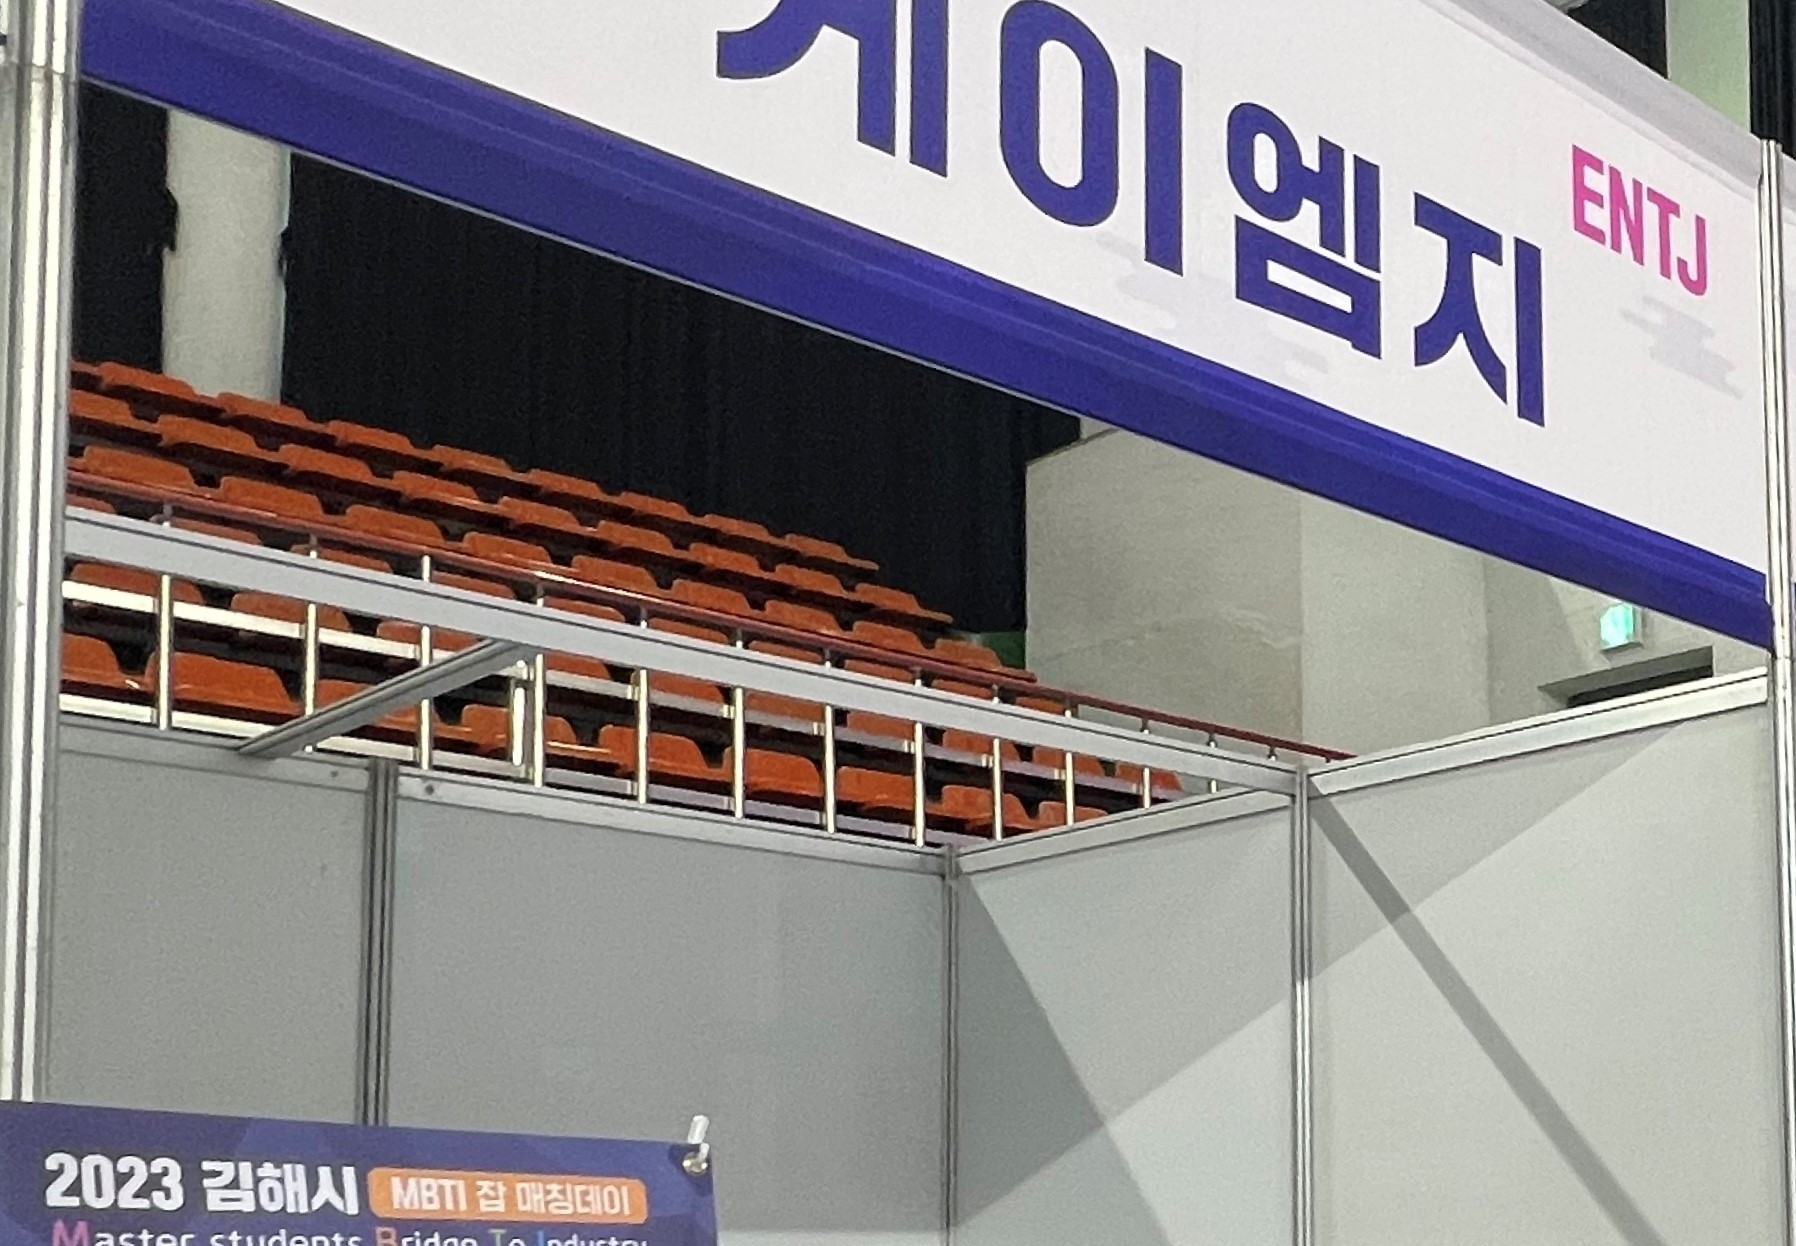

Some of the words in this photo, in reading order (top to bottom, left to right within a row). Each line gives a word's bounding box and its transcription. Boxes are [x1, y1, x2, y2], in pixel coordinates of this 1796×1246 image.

[1571, 143, 1708, 297] ENTJ
[45, 1152, 184, 1211] 2023
[200, 1160, 359, 1215] 김해시
[391, 1176, 466, 1211] MBTI
[476, 1180, 506, 1213] 잡
[516, 1182, 631, 1216] 매칭데이
